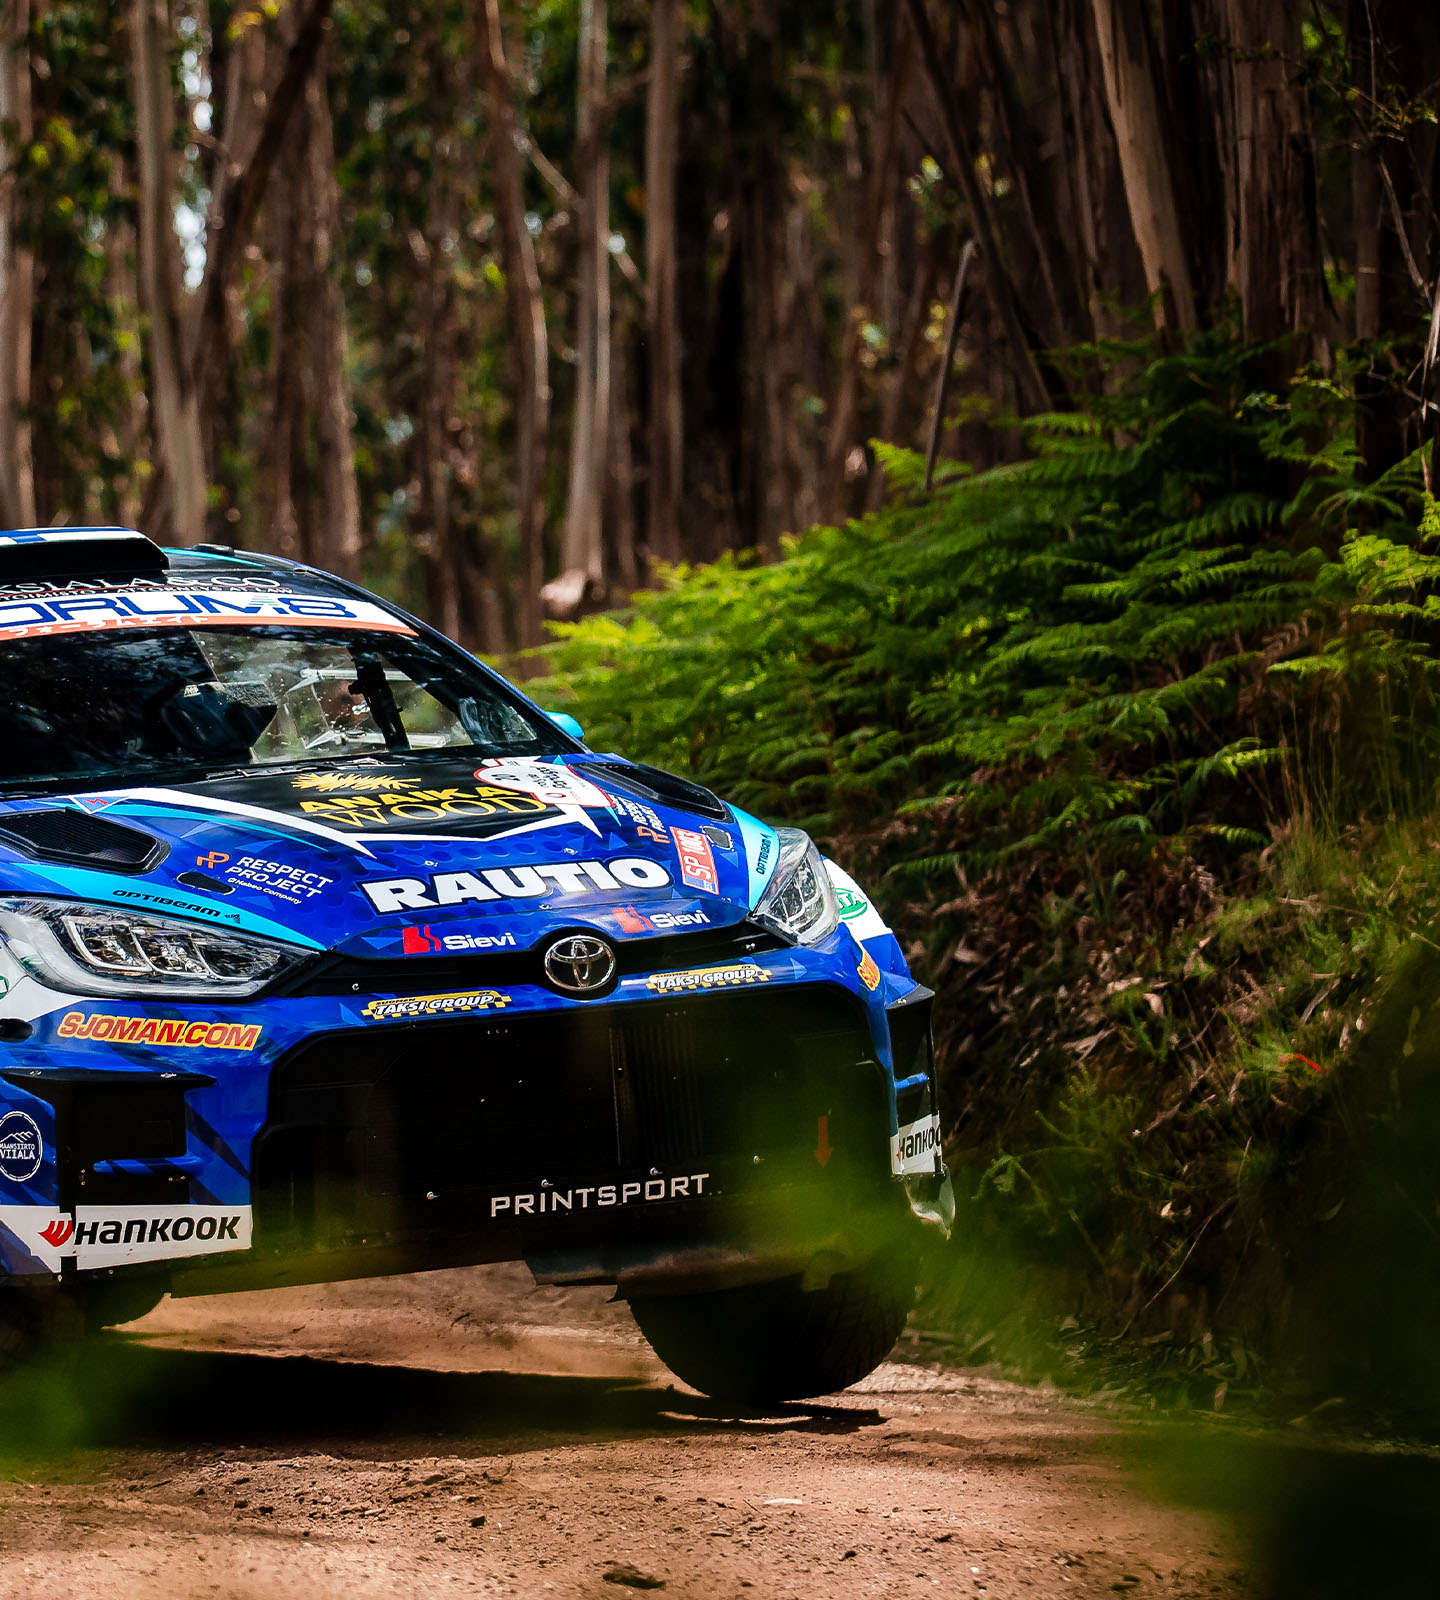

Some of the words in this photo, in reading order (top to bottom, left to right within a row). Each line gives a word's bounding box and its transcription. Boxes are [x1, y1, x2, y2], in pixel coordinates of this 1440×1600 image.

[299, 786, 521, 813] ANAIKA
[313, 797, 548, 828] WOOD
[236, 856, 333, 888] RESPECT
[683, 855, 712, 880] SP
[224, 865, 322, 898] PROJECT
[361, 858, 671, 913] RAUTIO
[112, 889, 221, 917] OPTIBEAM
[263, 887, 302, 904] Company
[649, 910, 711, 929] Sievi
[445, 932, 517, 950] Sievi
[657, 975, 700, 989] TAKSI
[702, 969, 756, 983] GROUP
[375, 1001, 427, 1016] TAKSI
[429, 995, 494, 1009] GROUP
[60, 1014, 260, 1049] SJOMAN.COM
[0, 1142, 35, 1151] MAANSIIRTO
[0, 1149, 35, 1160] VIIALA
[491, 1173, 709, 1217] PRINTSPORT
